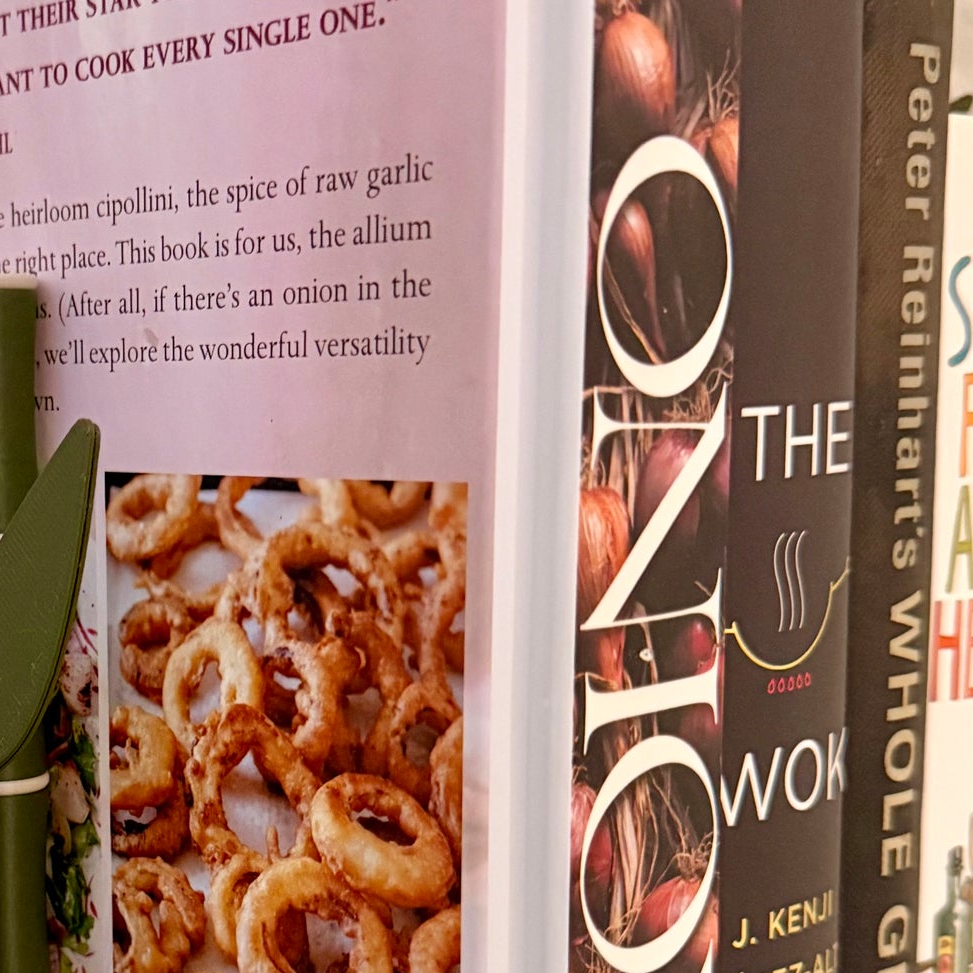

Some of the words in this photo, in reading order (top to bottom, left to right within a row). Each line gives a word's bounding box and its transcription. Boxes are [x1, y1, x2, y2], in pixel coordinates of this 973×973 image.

[16, 0, 79, 33] THEIR
[40, 62, 67, 88] TO
[75, 48, 135, 82] COOK
[142, 33, 215, 70] EVERY
[224, 14, 311, 55] SINGLE
[905, 42, 941, 222] Peter
[11, 198, 89, 227] heirloom
[96, 186, 179, 226] cipollini,
[187, 180, 219, 208] the
[226, 176, 277, 213] spice
[286, 166, 310, 197] of
[315, 169, 358, 193] raw
[366, 153, 433, 198] garlic
[15, 247, 55, 276] right
[61, 244, 111, 278] place.
[115, 238, 155, 264] This
[161, 232, 208, 262] book
[215, 232, 229, 256] is
[234, 227, 265, 255] for
[272, 232, 302, 254] us,
[309, 220, 345, 249] the
[352, 214, 432, 245] allium
[59, 292, 111, 326] (After
[118, 288, 146, 317] all,
[153, 285, 167, 312] if
[174, 283, 240, 312] there’s
[248, 289, 273, 307] an
[283, 278, 347, 305] onion
[358, 275, 379, 300] in
[391, 269, 432, 298] the
[43, 338, 84, 366] we’ll
[89, 337, 158, 372] explore
[163, 335, 195, 362] the
[199, 329, 308, 360] wonderful
[314, 325, 431, 366] versatility
[741, 401, 851, 482] THE
[890, 244, 935, 571] Reinhart’s
[880, 589, 923, 877] WHOLE
[719, 726, 847, 827] WOK
[732, 918, 758, 949] J.
[768, 889, 834, 941] KENJI
